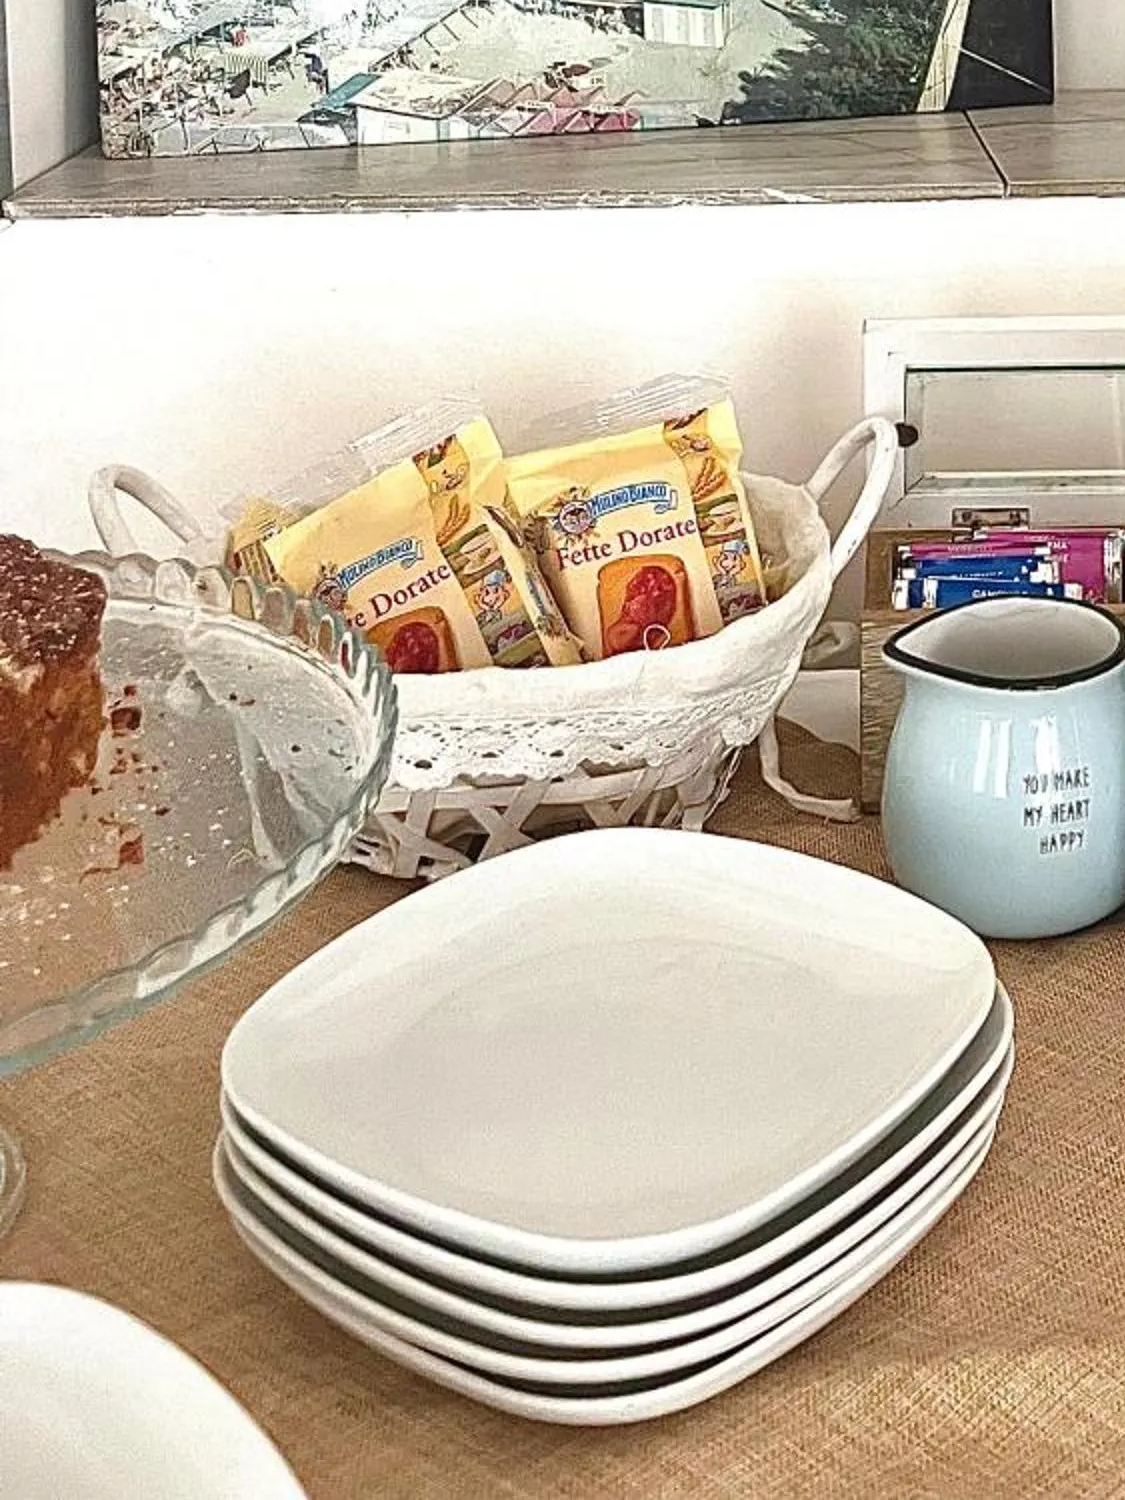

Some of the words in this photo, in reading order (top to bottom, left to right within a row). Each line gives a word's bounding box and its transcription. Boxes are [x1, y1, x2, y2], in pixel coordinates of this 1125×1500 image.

[557, 542, 613, 571] Fette
[618, 518, 698, 552] Dorate
[369, 563, 451, 619] Dorate
[1023, 772, 1048, 795] YOU
[1053, 766, 1090, 792] MAKE
[1023, 804, 1043, 828] MY
[1050, 798, 1090, 825] HEART
[1039, 829, 1085, 855] HAPPY
